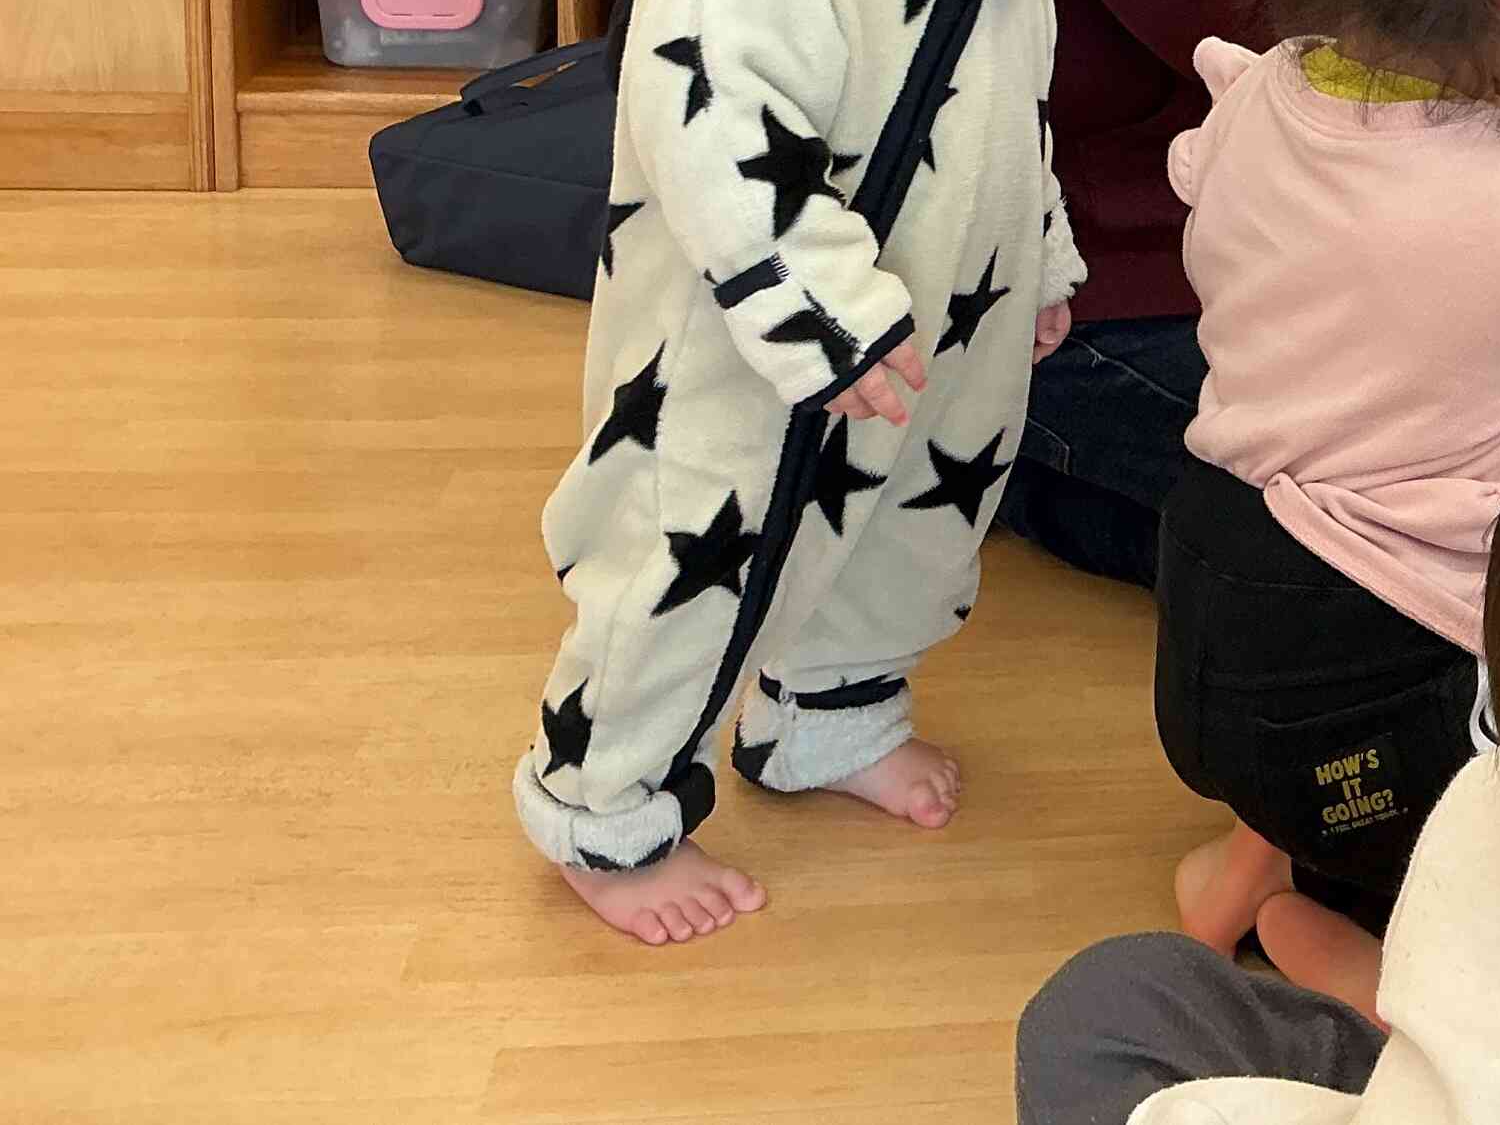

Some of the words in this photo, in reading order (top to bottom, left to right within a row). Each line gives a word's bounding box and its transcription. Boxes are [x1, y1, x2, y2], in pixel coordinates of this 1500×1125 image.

[1315, 749, 1379, 786] HOW'S
[1342, 777, 1362, 800] IT
[1322, 789, 1394, 824] GOING?
